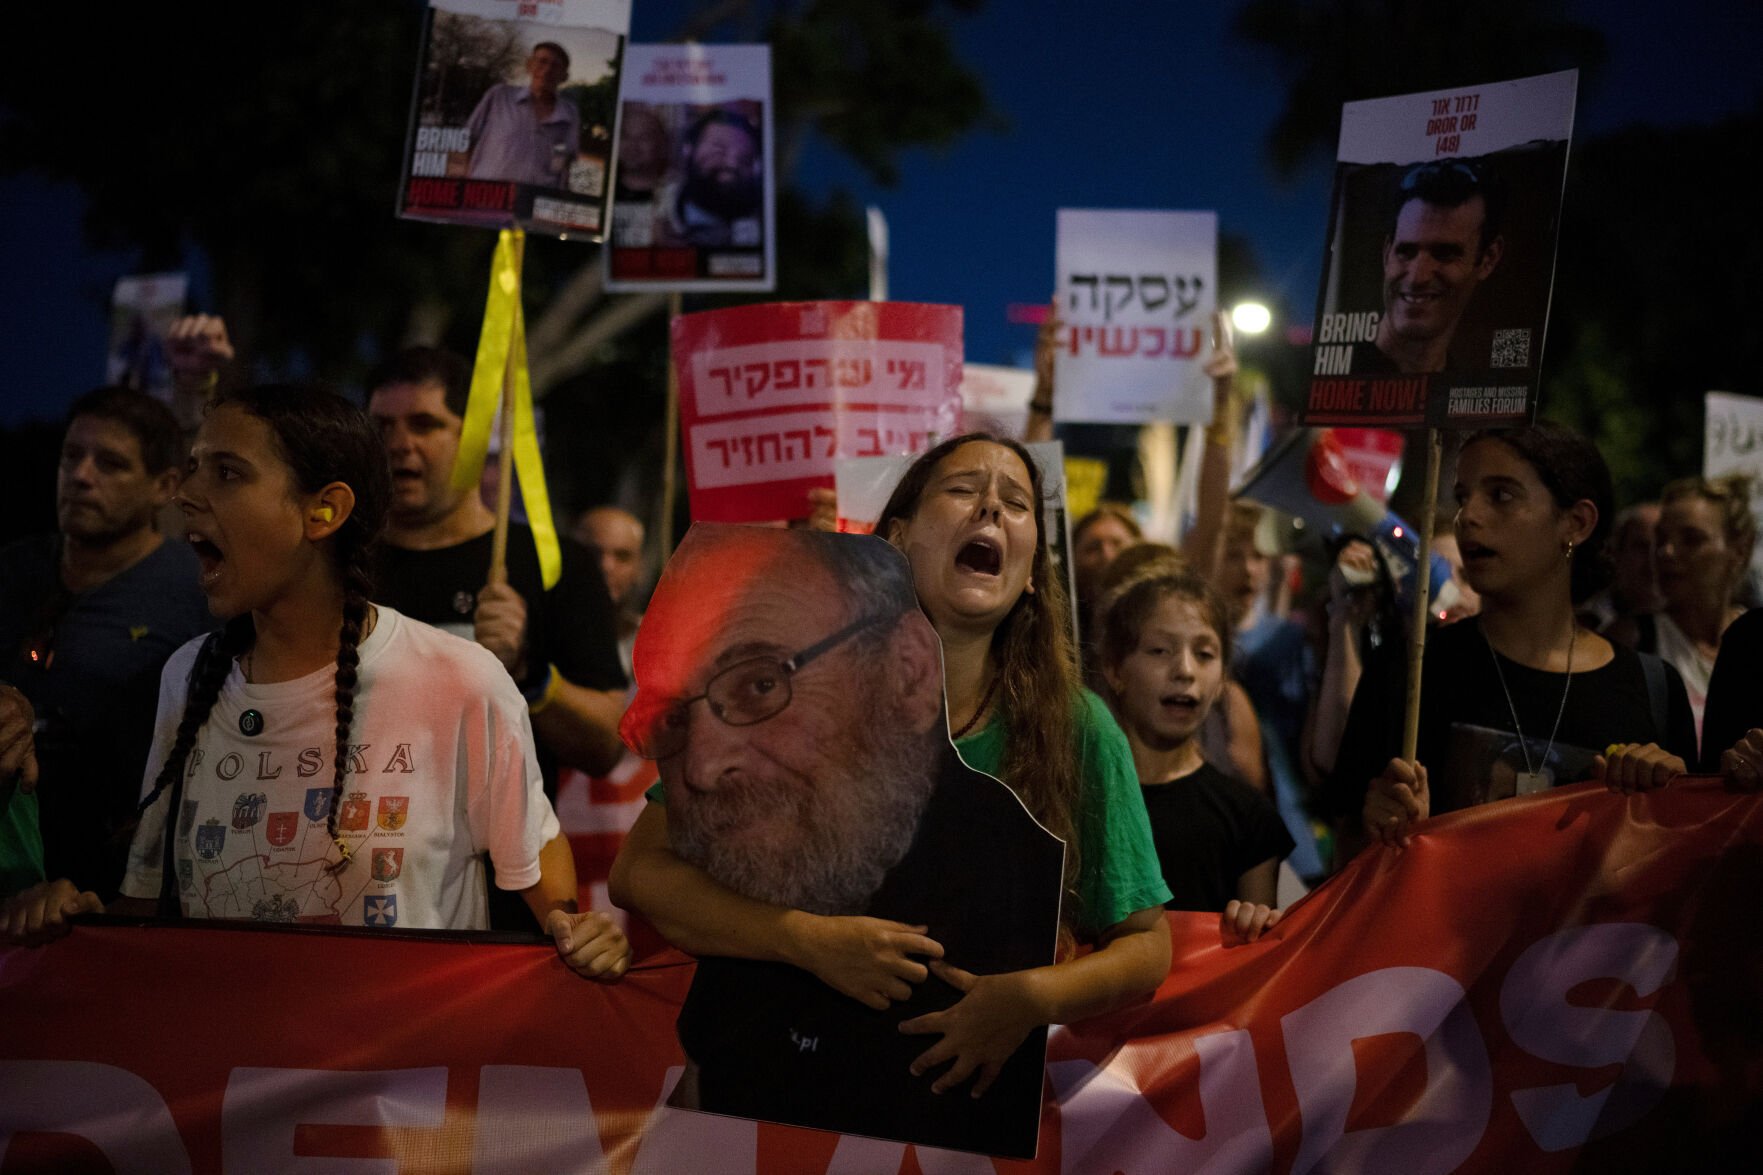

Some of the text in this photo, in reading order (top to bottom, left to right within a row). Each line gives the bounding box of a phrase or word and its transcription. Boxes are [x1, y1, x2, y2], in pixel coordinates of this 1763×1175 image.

[1426, 113, 1477, 136] DROR OR
[415, 126, 470, 153] BRING
[1436, 134, 1460, 156] (48)
[411, 151, 448, 177] HIM
[1069, 274, 1203, 321] עסקה
[1319, 311, 1379, 343] BRING
[1068, 326, 1203, 359] עכשיו
[1313, 345, 1354, 376] HIM
[1307, 376, 1428, 411] HOME NOW!
[1447, 398, 1527, 414] FAMILIES FORUM
[1484, 386, 1497, 398] AND
[1498, 386, 1528, 398] MISSING
[857, 429, 929, 456] חיב
[187, 743, 415, 781] POLSKA
[0, 923, 1680, 1174] EMNDS
